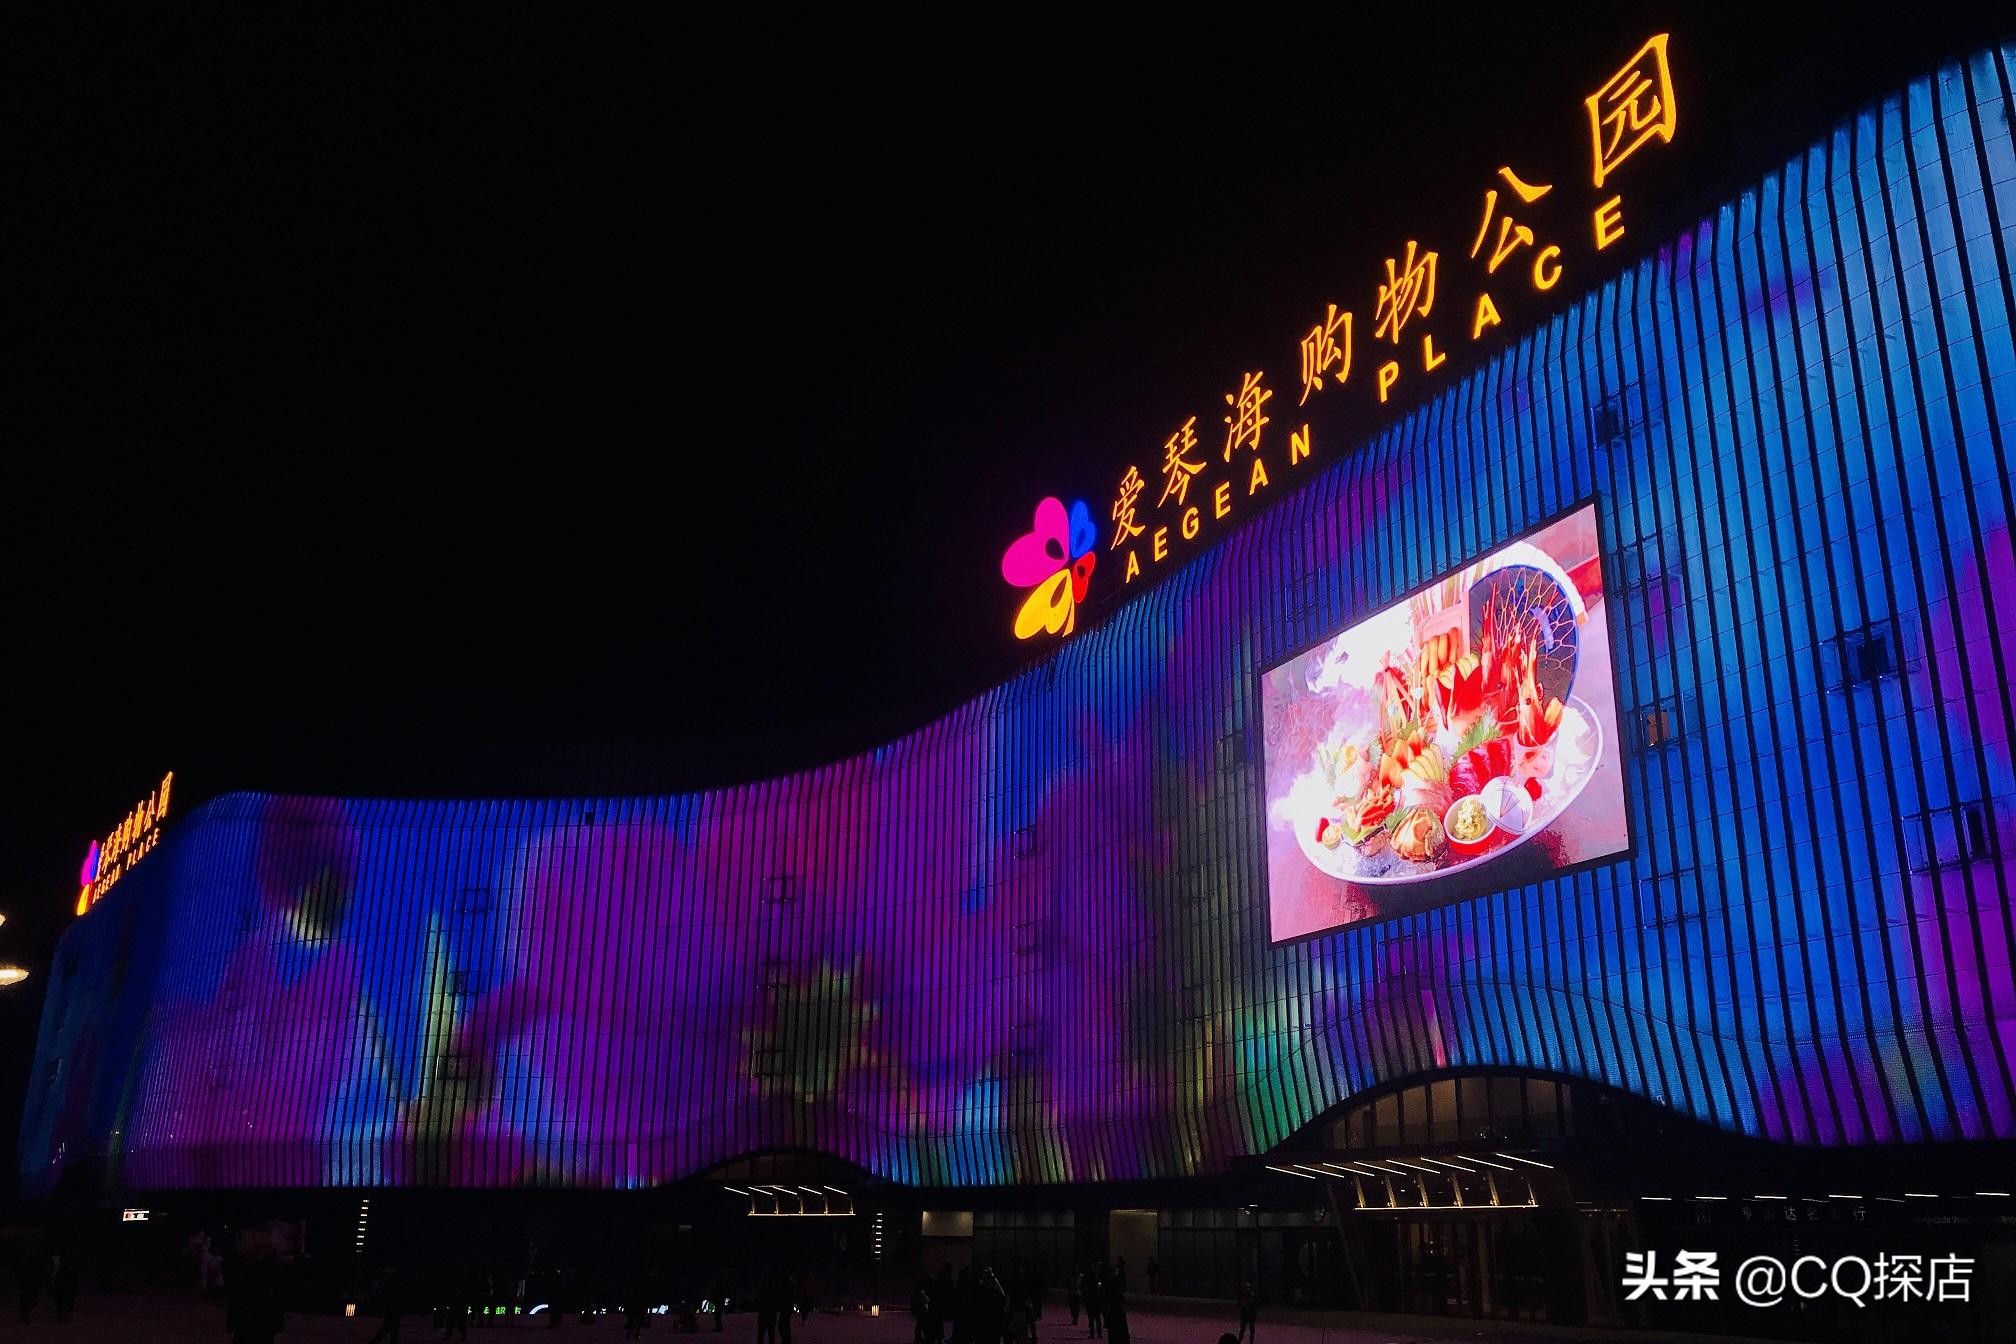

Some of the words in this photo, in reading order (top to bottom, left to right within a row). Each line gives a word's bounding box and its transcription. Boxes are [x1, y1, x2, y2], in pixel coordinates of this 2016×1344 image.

[1111, 33, 1677, 551] 爱琴海购物公园
[1126, 423, 1311, 584] AEGEAN
[1379, 195, 1625, 403] PLACE
